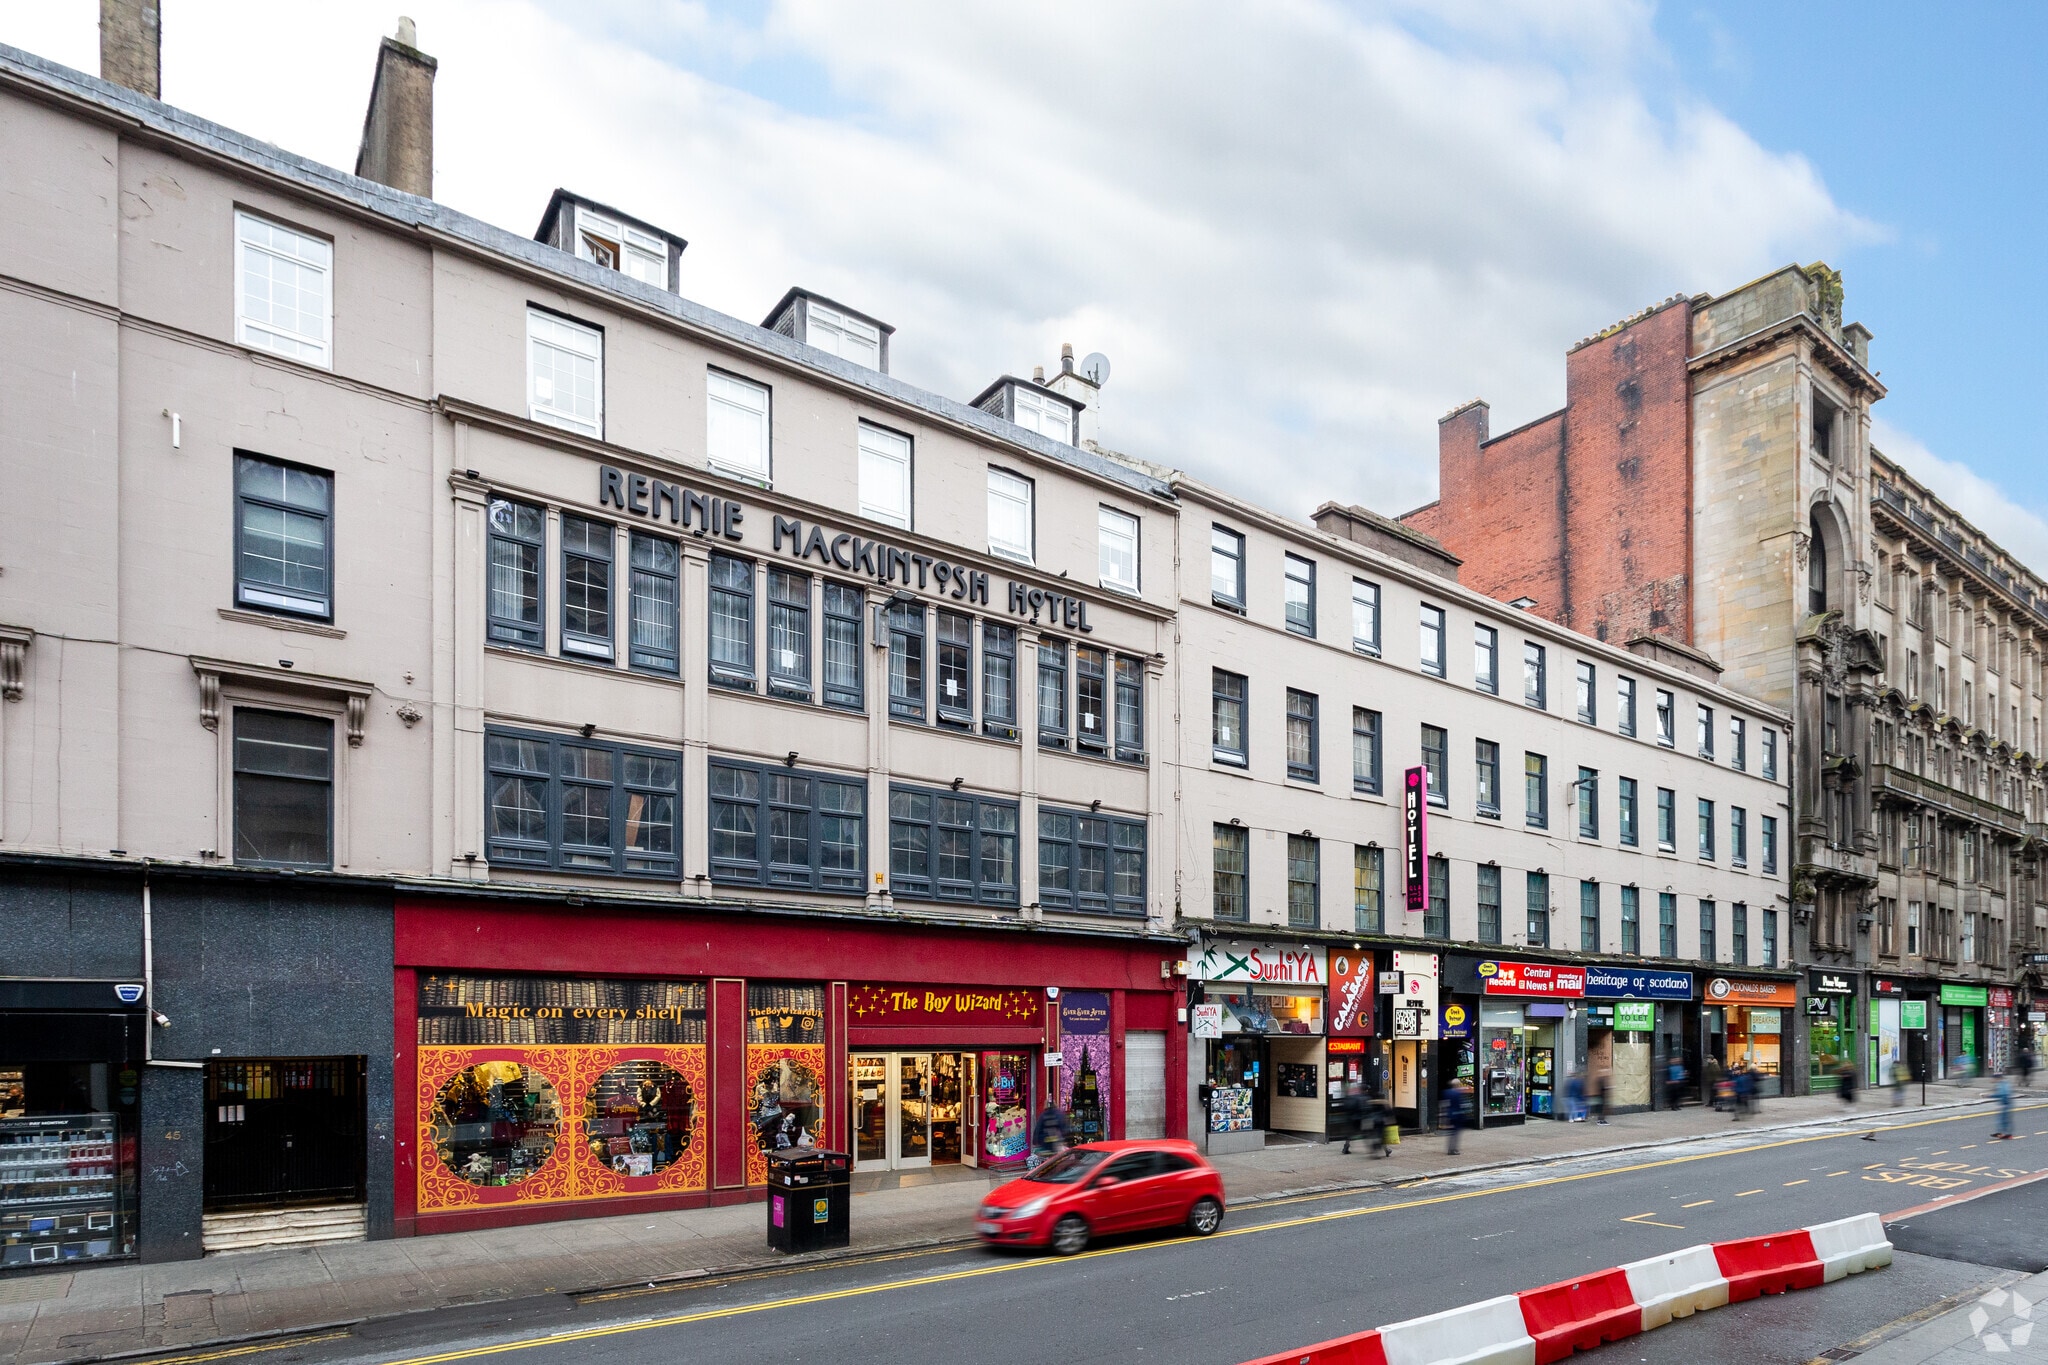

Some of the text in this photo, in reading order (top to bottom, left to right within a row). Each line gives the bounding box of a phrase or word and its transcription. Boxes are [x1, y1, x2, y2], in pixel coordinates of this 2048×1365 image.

[600, 464, 1094, 632] RENNIE MACKINTOSH HOTEL
[1407, 791, 1417, 879] HOTEL
[2034, 954, 2048, 962] HOTE
[1249, 947, 1319, 983] SushiYA
[1523, 967, 1552, 977] Central
[1558, 973, 1578, 981] sunday
[1489, 978, 1516, 987] Record
[1526, 980, 1547, 991] News
[1556, 975, 1582, 989] mail
[1586, 972, 1688, 991] heritage of scotland
[1334, 957, 1370, 1031] CALABASH
[890, 991, 1004, 1013] The Boy Wizard
[1806, 997, 1828, 1010] PV
[465, 1002, 684, 1025] Magic on every shelf
[1196, 1006, 1217, 1017] SushiYA
[1753, 1016, 1779, 1024] BREAKFAST
[1328, 1043, 1361, 1051] ESTAURANT
[1373, 1058, 1379, 1066] 57
[165, 1131, 182, 1140] 45
[1899, 1162, 2029, 1178] STOP
[1861, 1171, 1972, 1189] BUS
